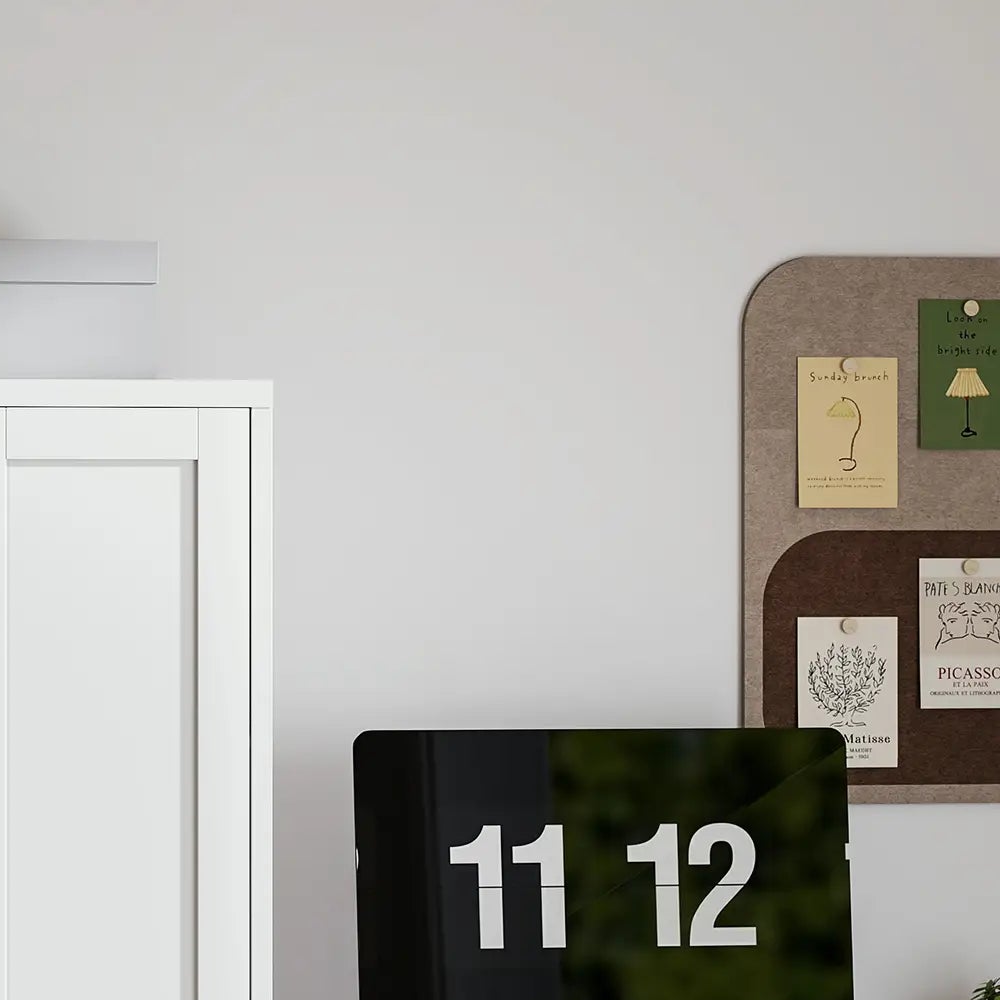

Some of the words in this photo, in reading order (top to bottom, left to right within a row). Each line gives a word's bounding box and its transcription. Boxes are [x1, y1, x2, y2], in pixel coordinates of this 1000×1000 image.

[958, 328, 976, 339] the
[937, 344, 971, 357] bright
[976, 345, 998, 356] side
[809, 371, 848, 384] Sunday
[854, 371, 889, 382] brunch
[843, 733, 891, 744] Matisse
[449, 824, 567, 950] 11
[626, 822, 757, 948] 12
